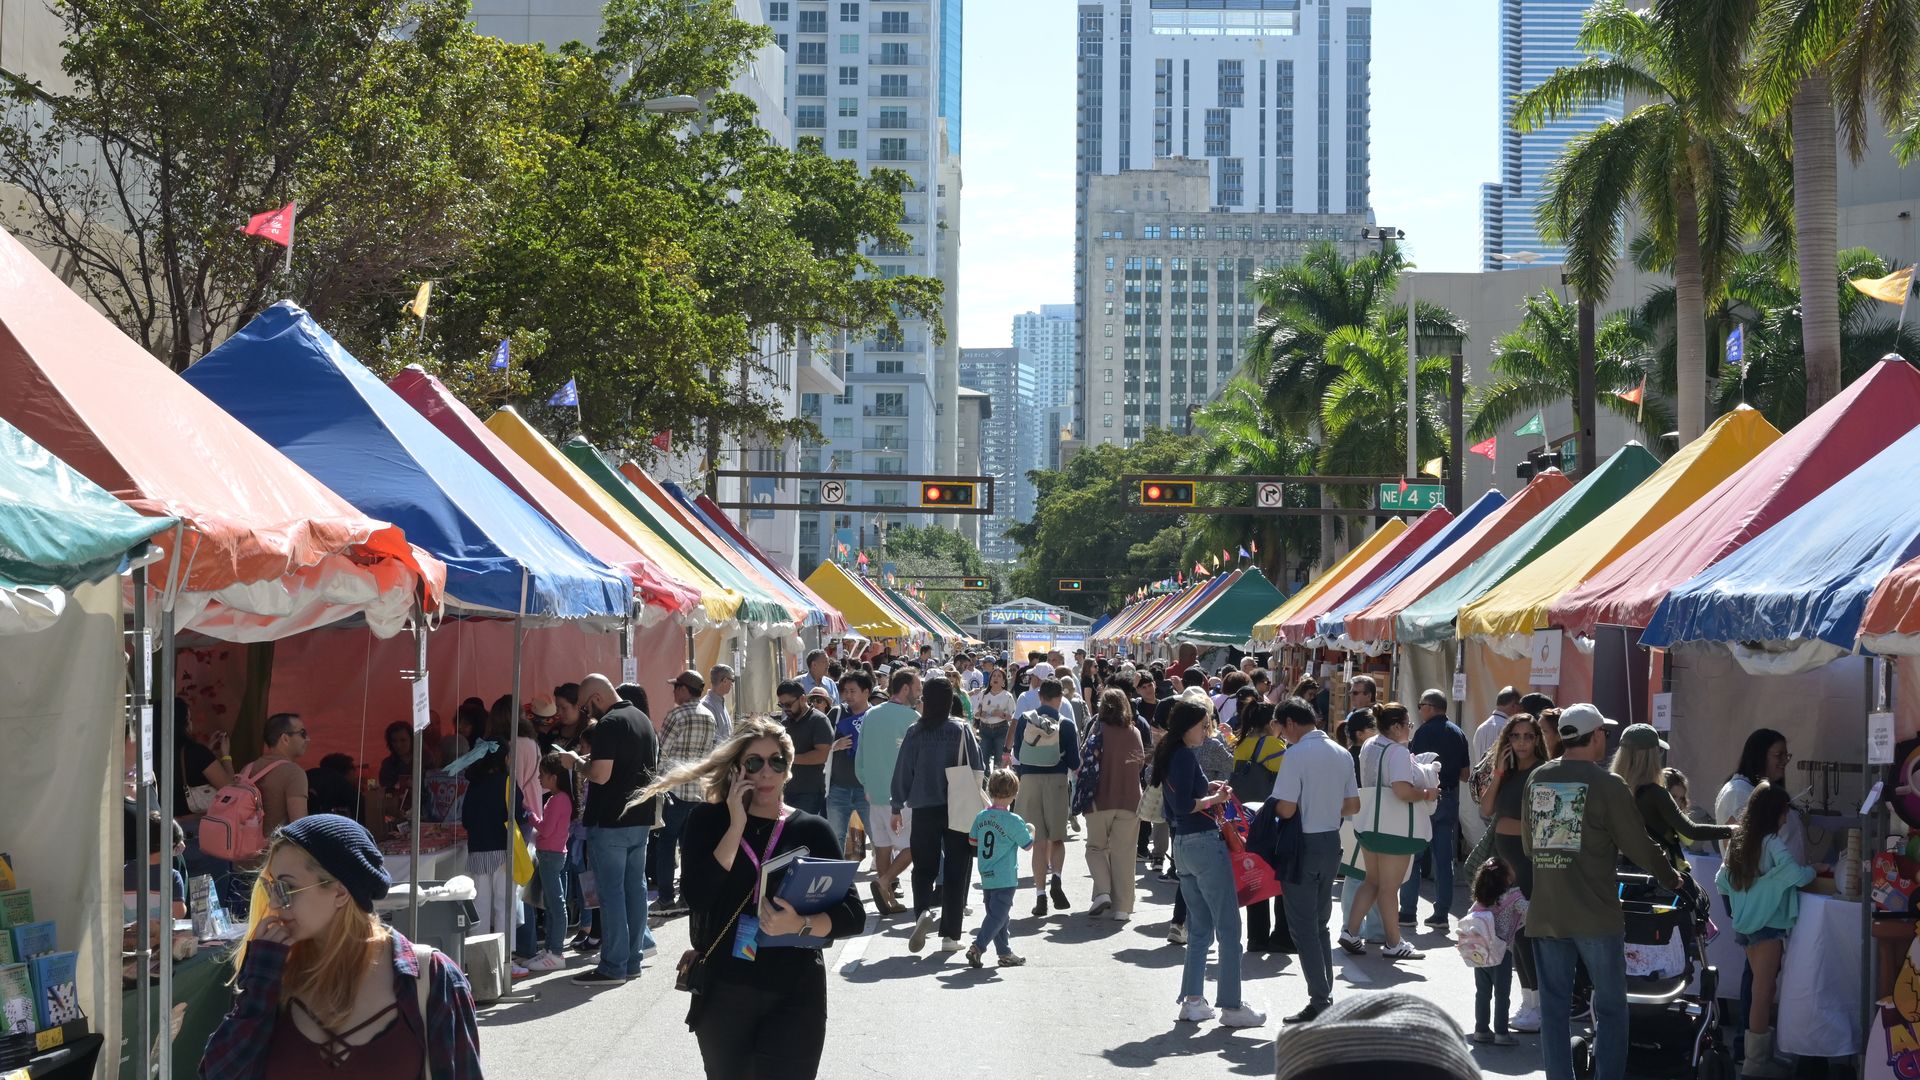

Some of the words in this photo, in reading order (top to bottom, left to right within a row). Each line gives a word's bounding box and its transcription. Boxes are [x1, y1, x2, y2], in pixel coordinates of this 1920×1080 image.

[1383, 491, 1398, 503] NE
[1408, 490, 1418, 505] 4
[1429, 492, 1442, 504] ST
[991, 611, 1043, 621] PAVILION
[982, 830, 995, 860] 9
